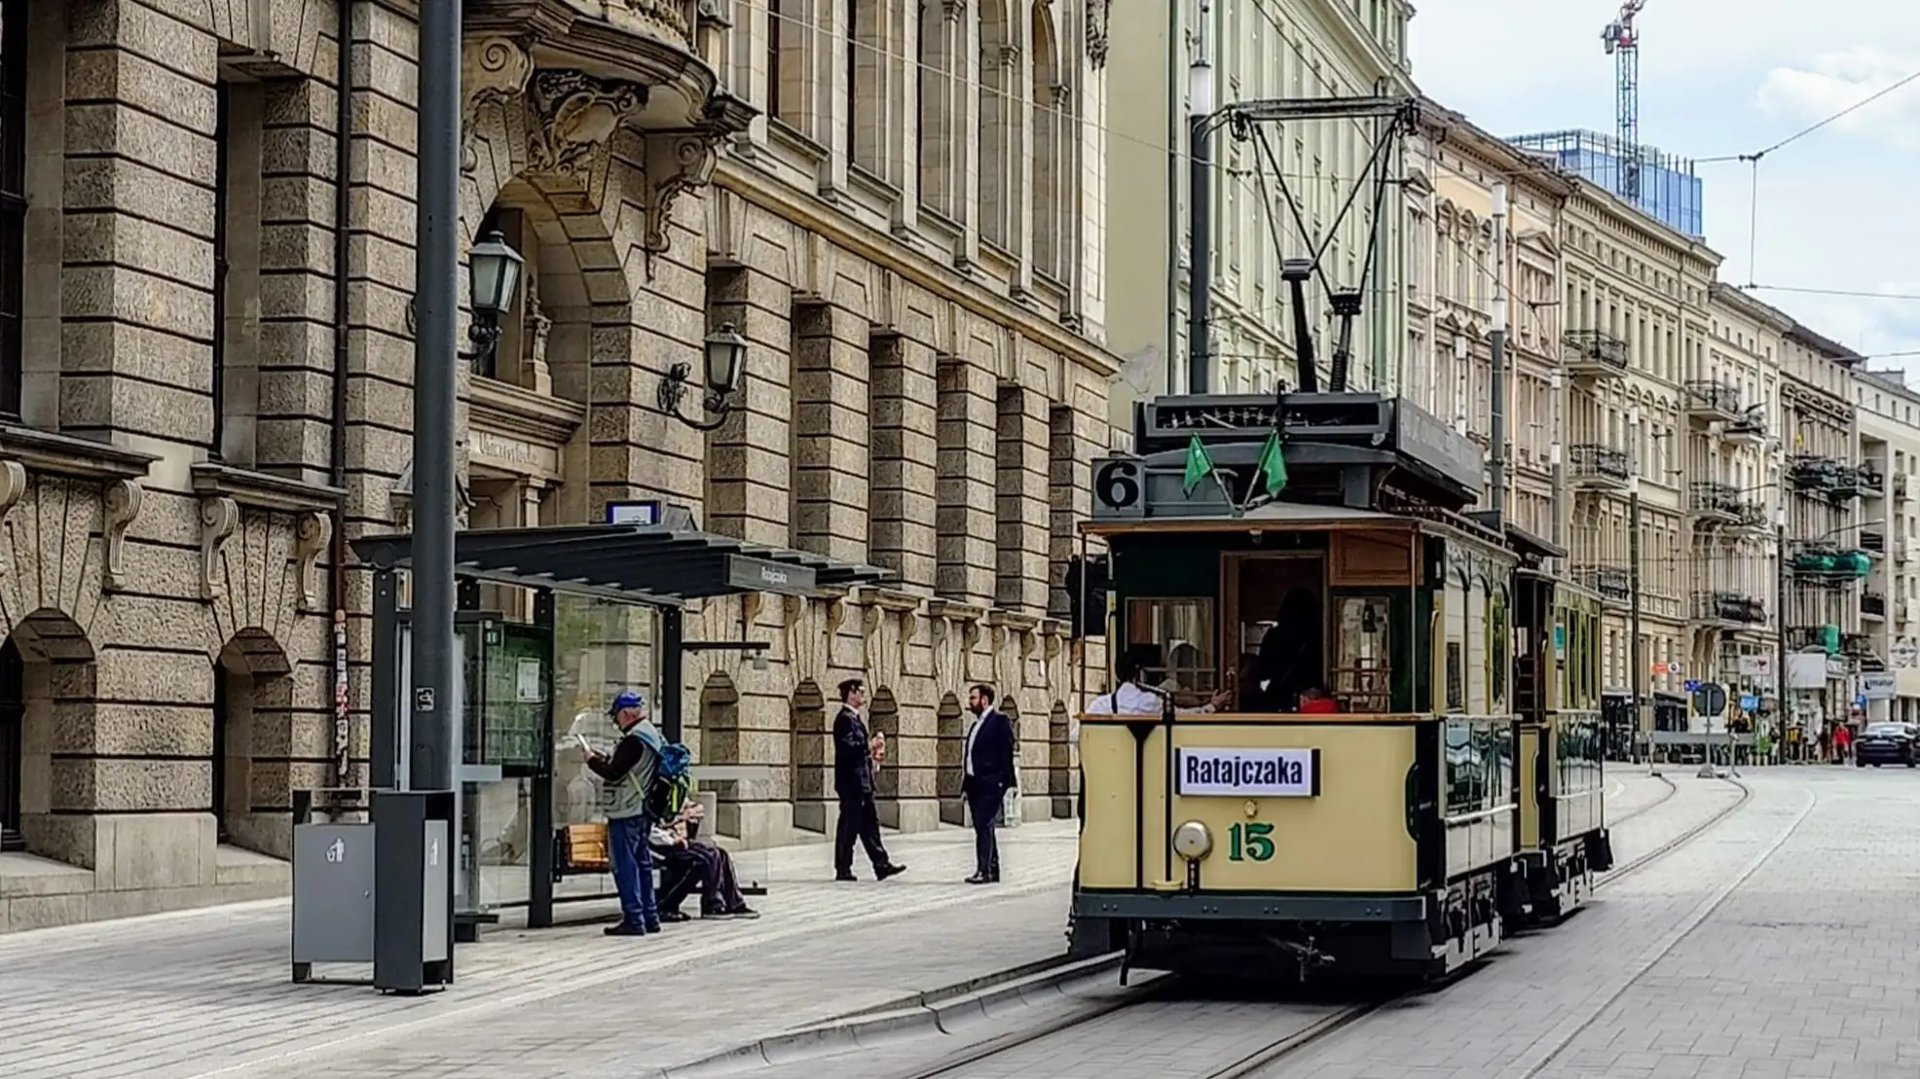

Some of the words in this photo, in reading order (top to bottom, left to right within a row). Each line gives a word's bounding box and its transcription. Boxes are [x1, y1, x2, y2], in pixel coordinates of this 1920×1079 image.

[1096, 461, 1139, 511] 6
[1186, 755, 1303, 787] Ratajczaka
[1227, 822, 1275, 862] 15
